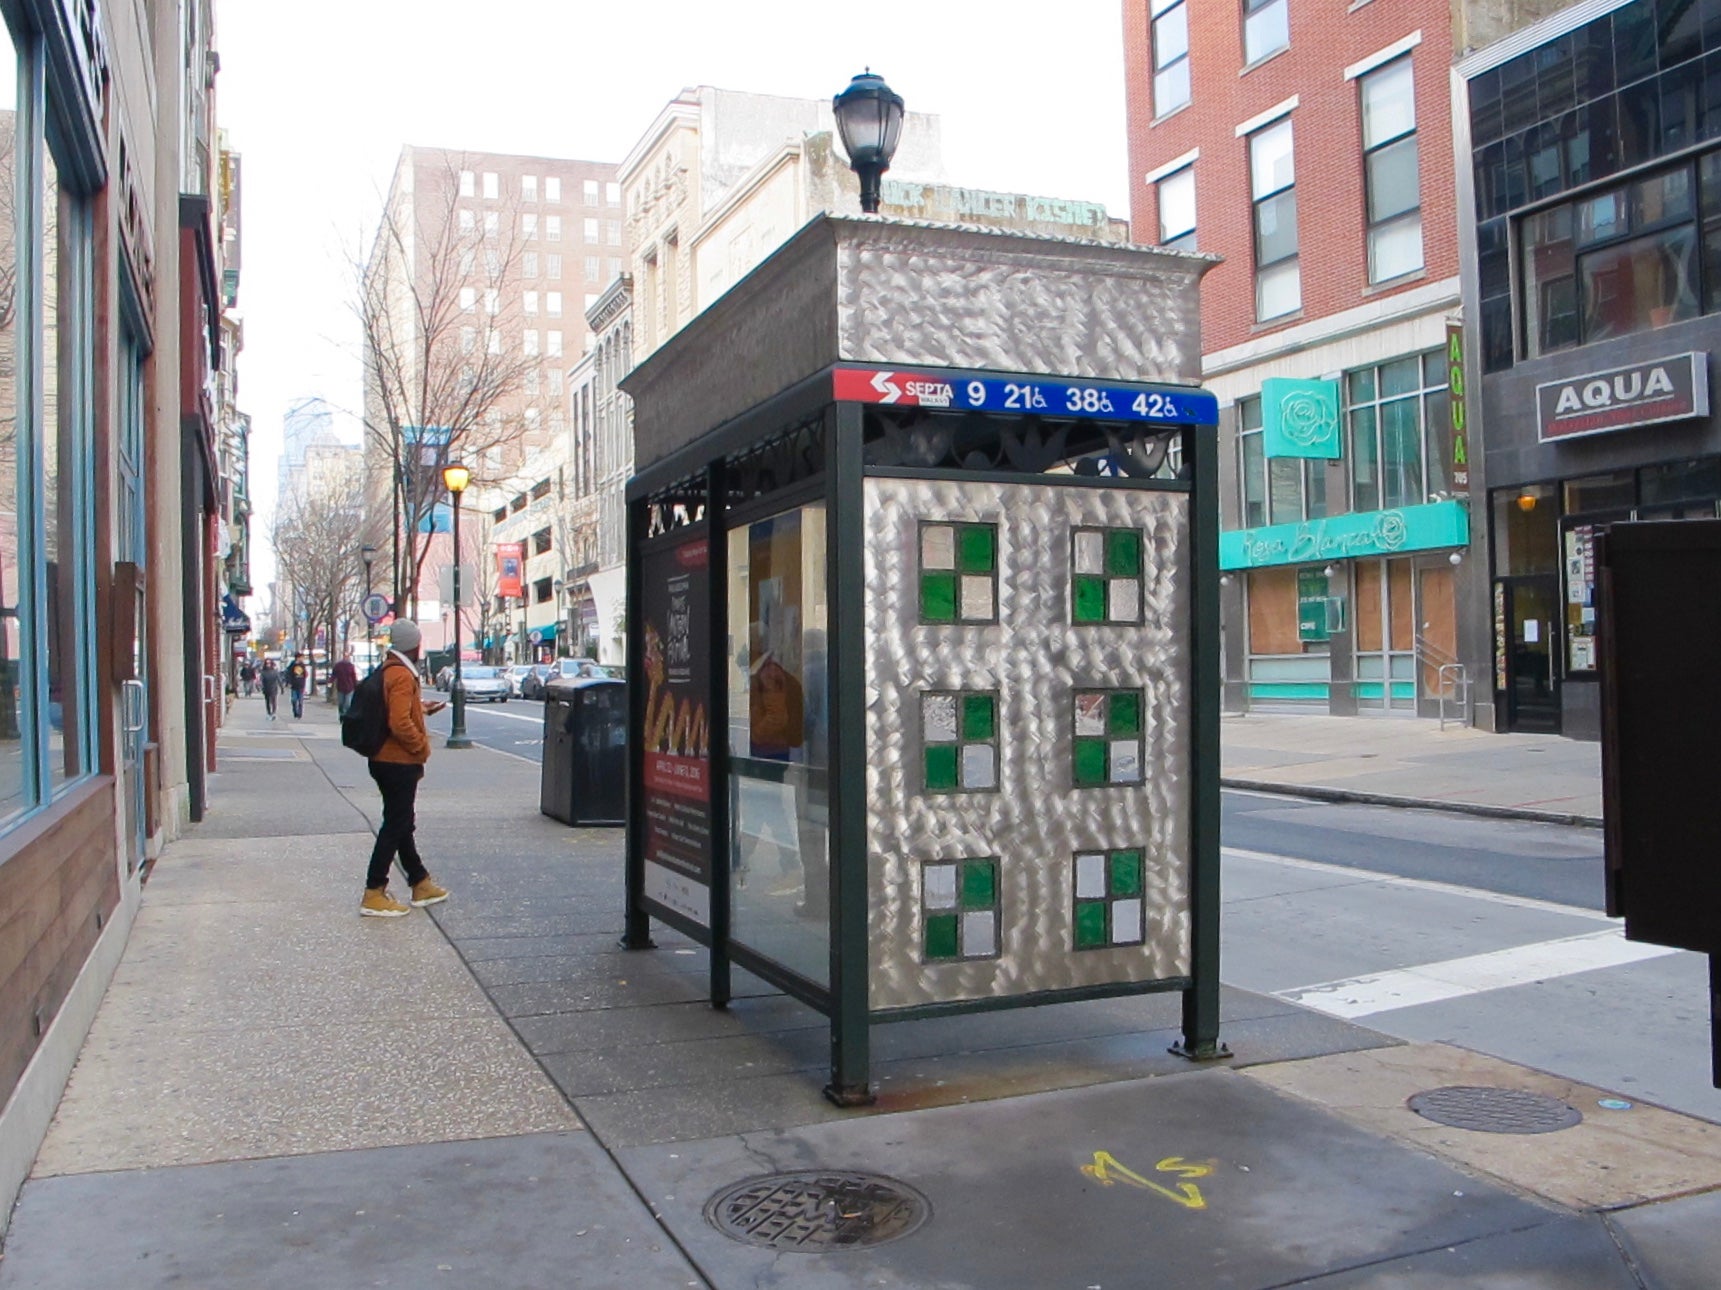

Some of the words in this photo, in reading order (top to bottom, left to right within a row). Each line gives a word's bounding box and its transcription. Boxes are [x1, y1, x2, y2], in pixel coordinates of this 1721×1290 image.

[905, 381, 954, 399] SEPTA
[967, 381, 987, 407] 9
[1003, 383, 1032, 409] 21
[1065, 387, 1100, 412] 38
[1131, 393, 1165, 418] 42
[1450, 332, 1467, 464] AQUA
[1555, 366, 1675, 415] AQUA
